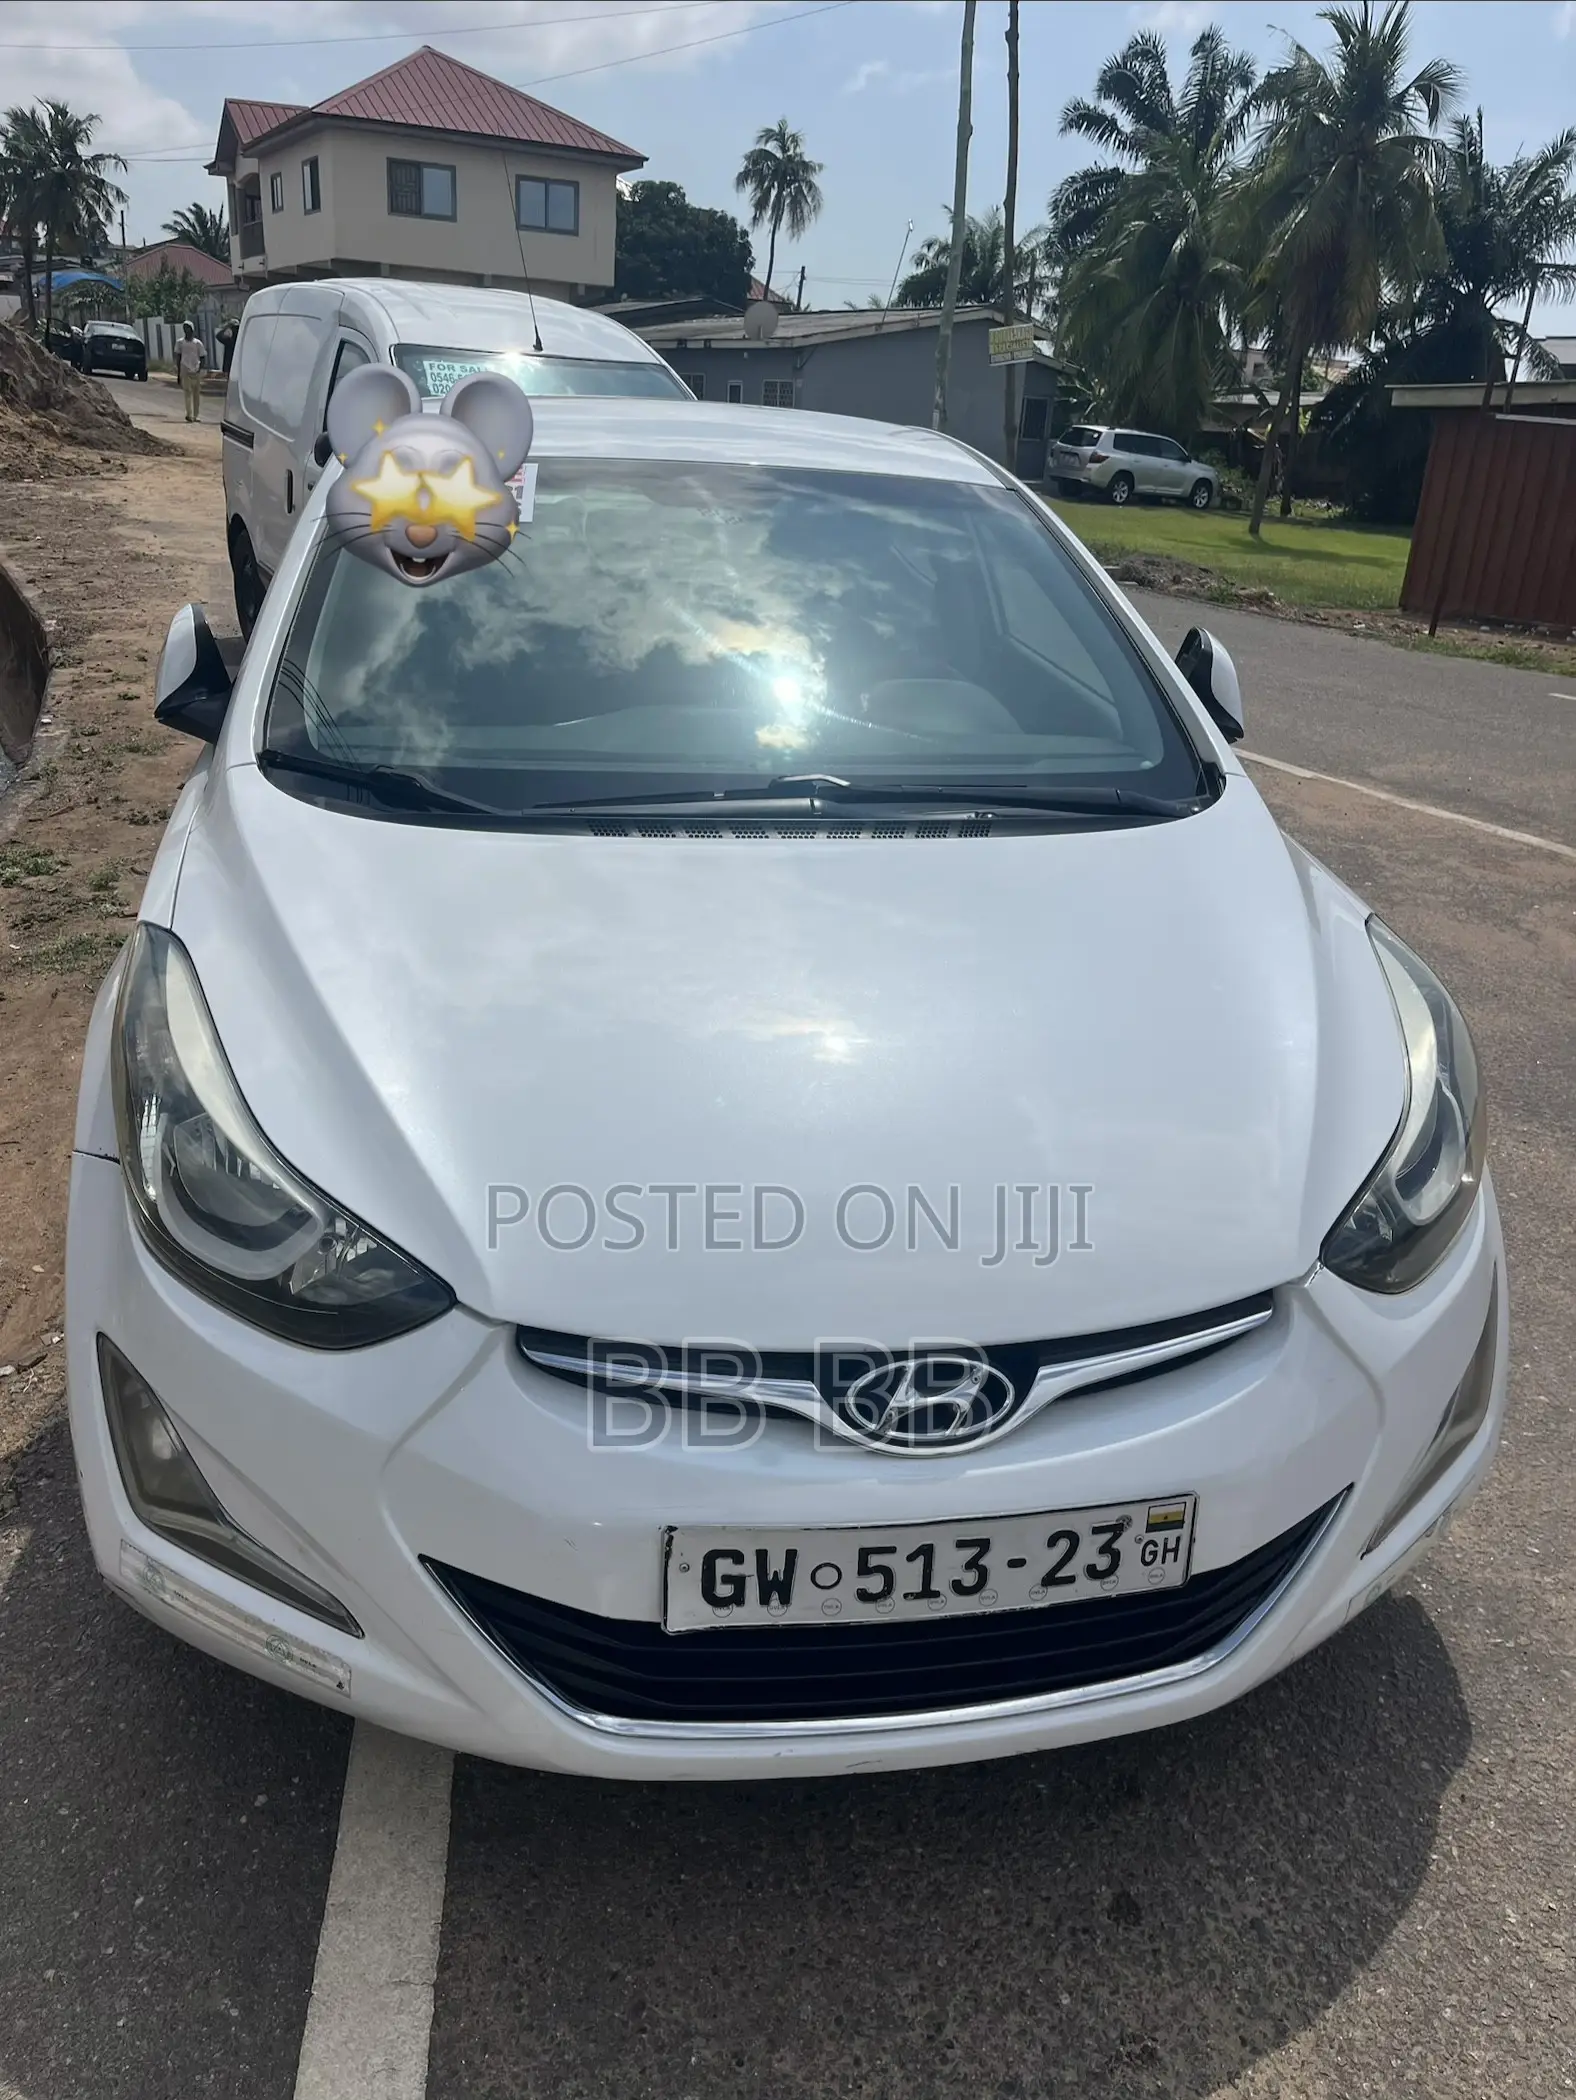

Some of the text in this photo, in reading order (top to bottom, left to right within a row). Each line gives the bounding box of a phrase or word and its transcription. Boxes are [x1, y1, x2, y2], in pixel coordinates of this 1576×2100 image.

[429, 363, 488, 373] FOR SAL
[1140, 1535, 1182, 1567] GH
[701, 1549, 798, 1607] GW
